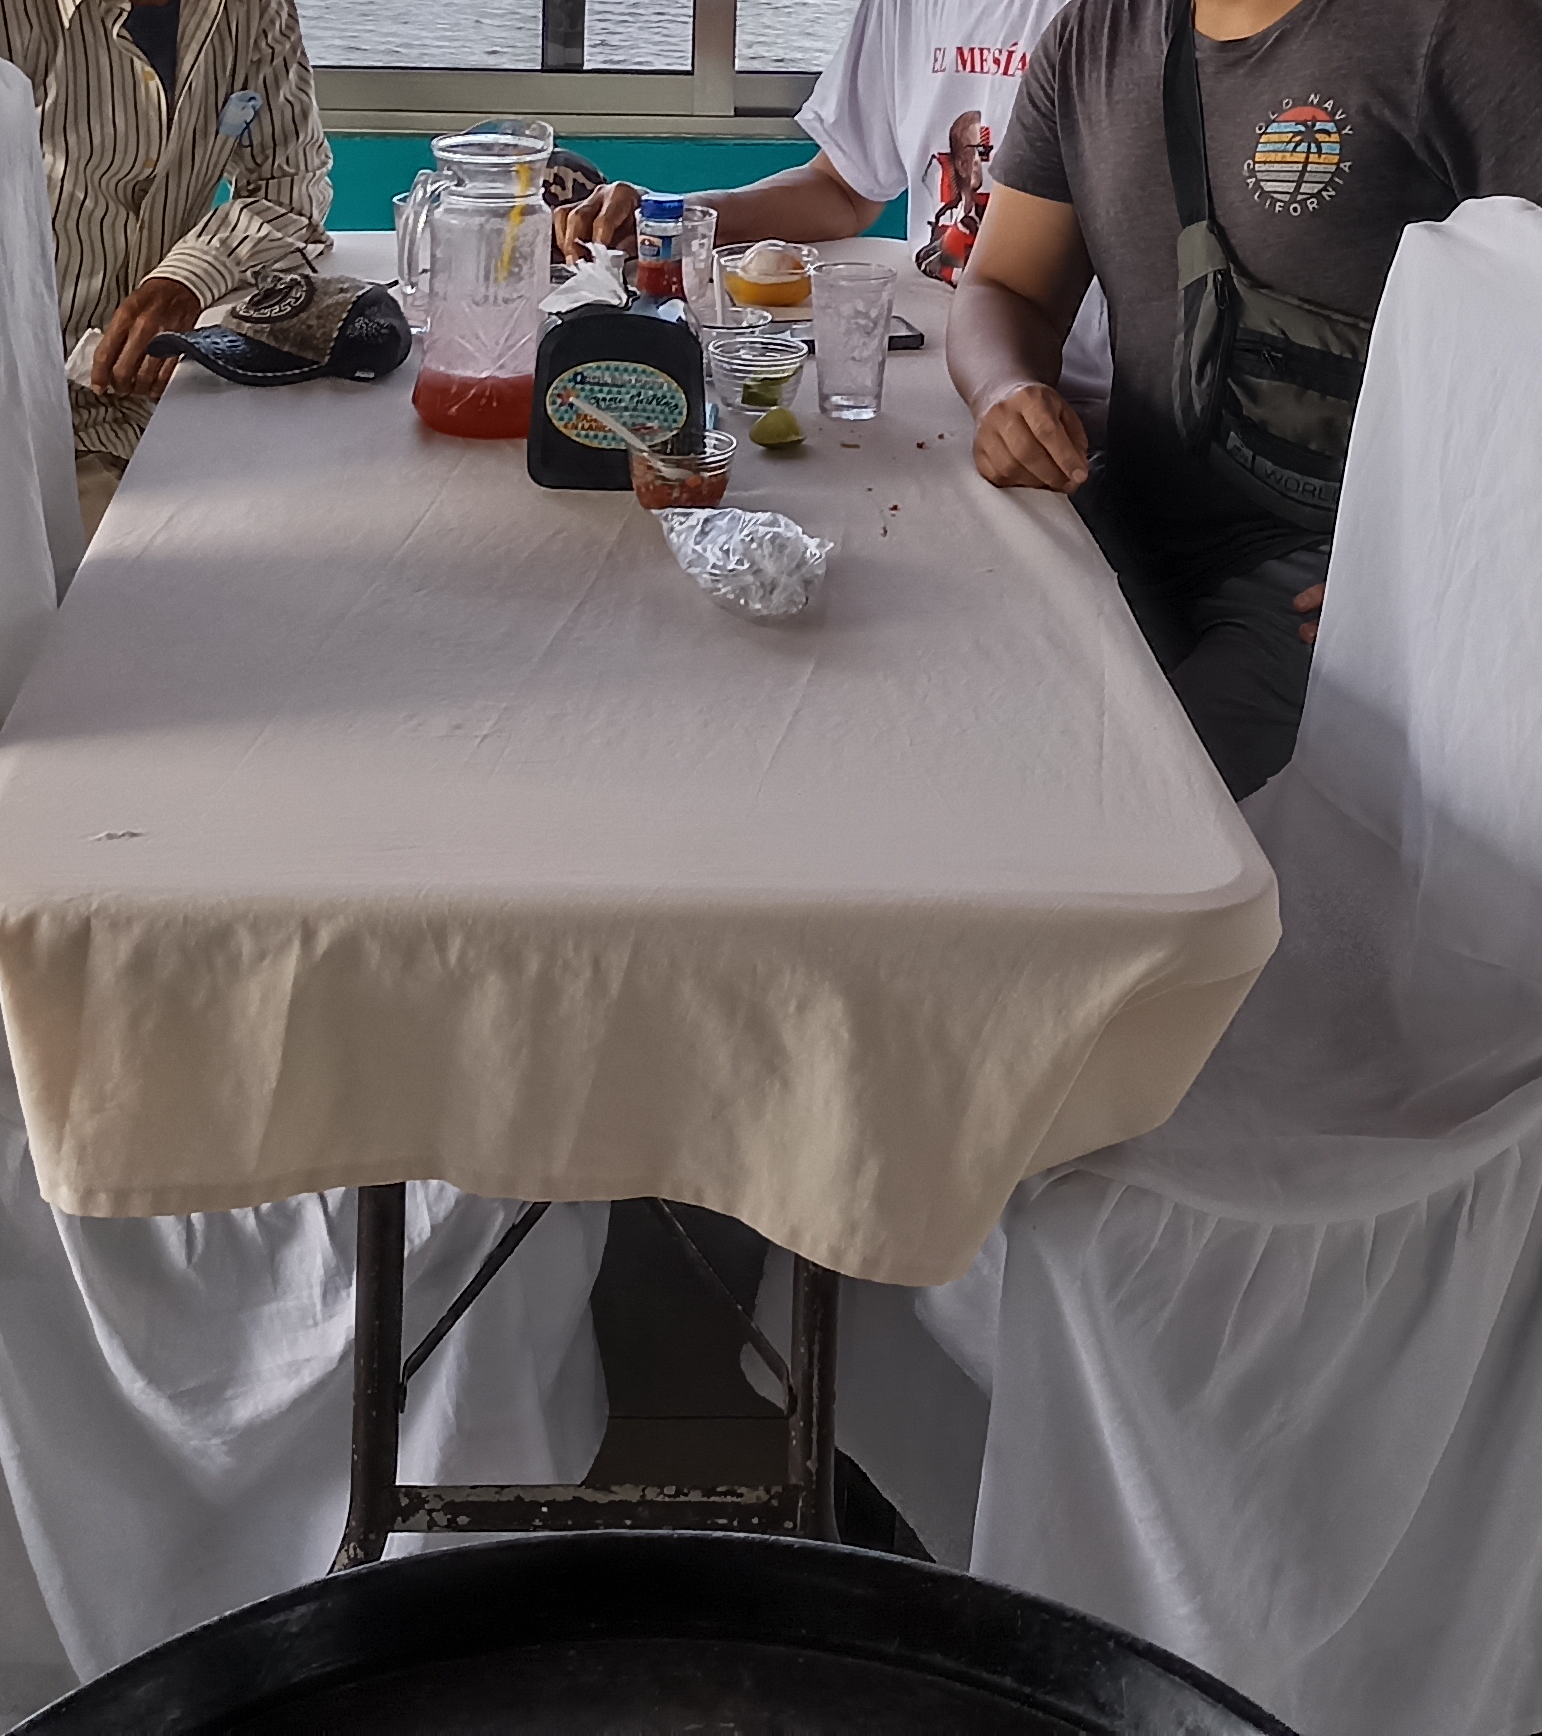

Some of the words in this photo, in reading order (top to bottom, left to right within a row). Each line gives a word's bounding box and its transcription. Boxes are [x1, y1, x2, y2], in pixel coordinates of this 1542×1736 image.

[932, 47, 946, 73] EL
[1256, 98, 1293, 134] OLD
[1307, 93, 1353, 135] NAVY
[1243, 160, 1352, 216] CALIFORNIA
